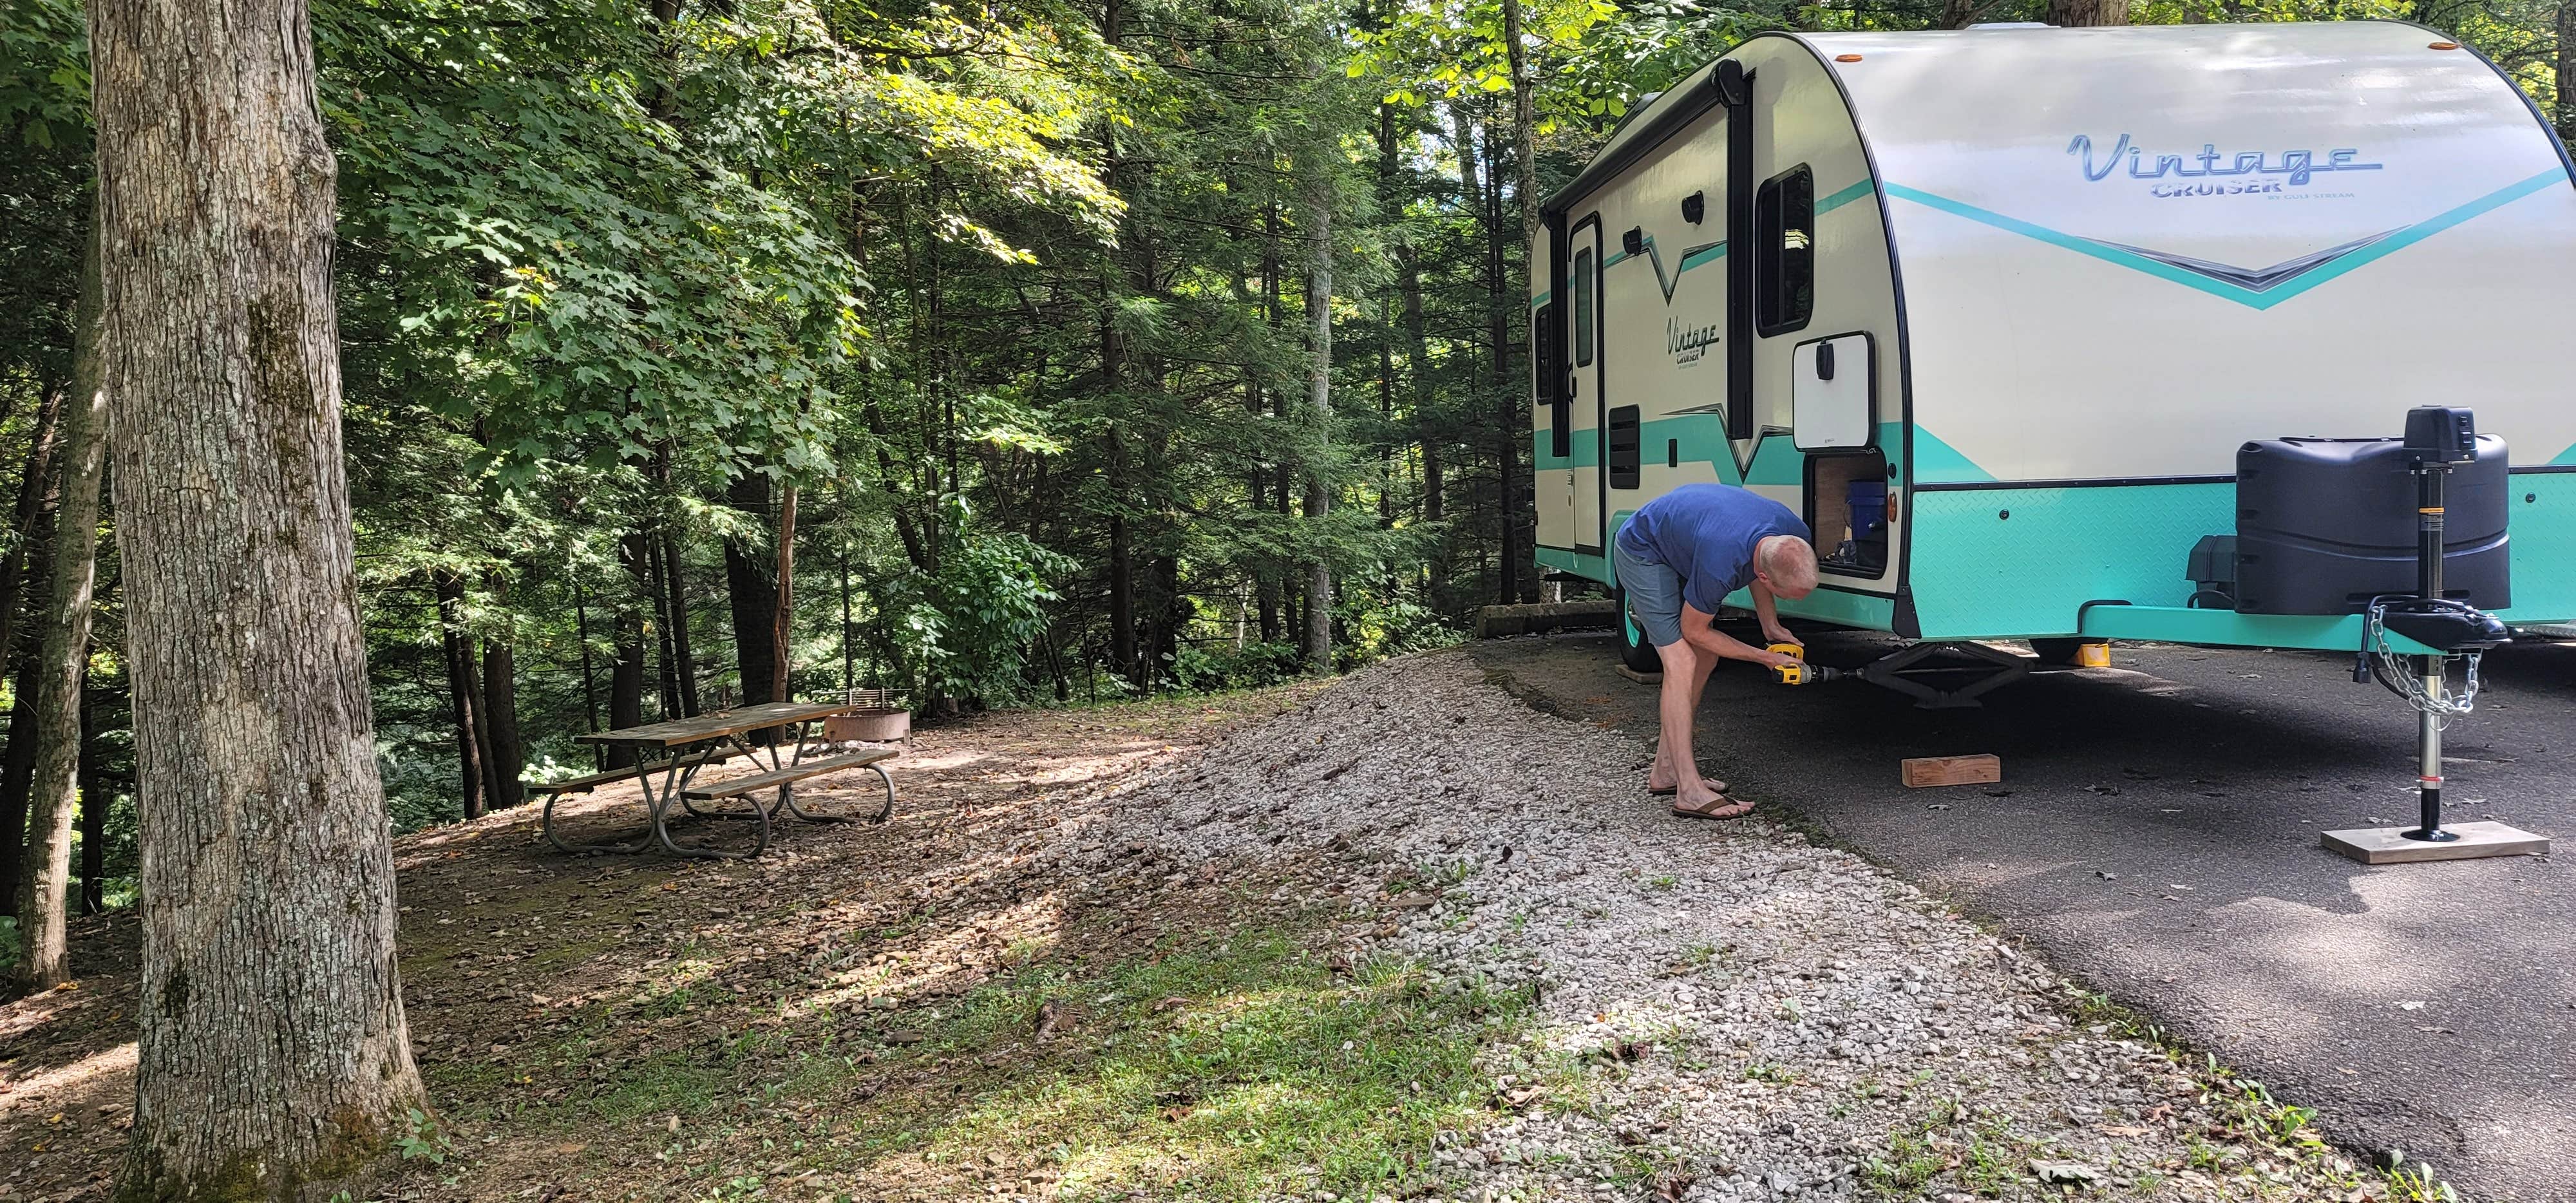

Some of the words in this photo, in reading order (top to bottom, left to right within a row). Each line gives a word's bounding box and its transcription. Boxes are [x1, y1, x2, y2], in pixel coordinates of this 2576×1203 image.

[2067, 133, 2383, 185] Vintage
[2150, 179, 2283, 198] CRUISER
[1667, 315, 1719, 356] Vintage
